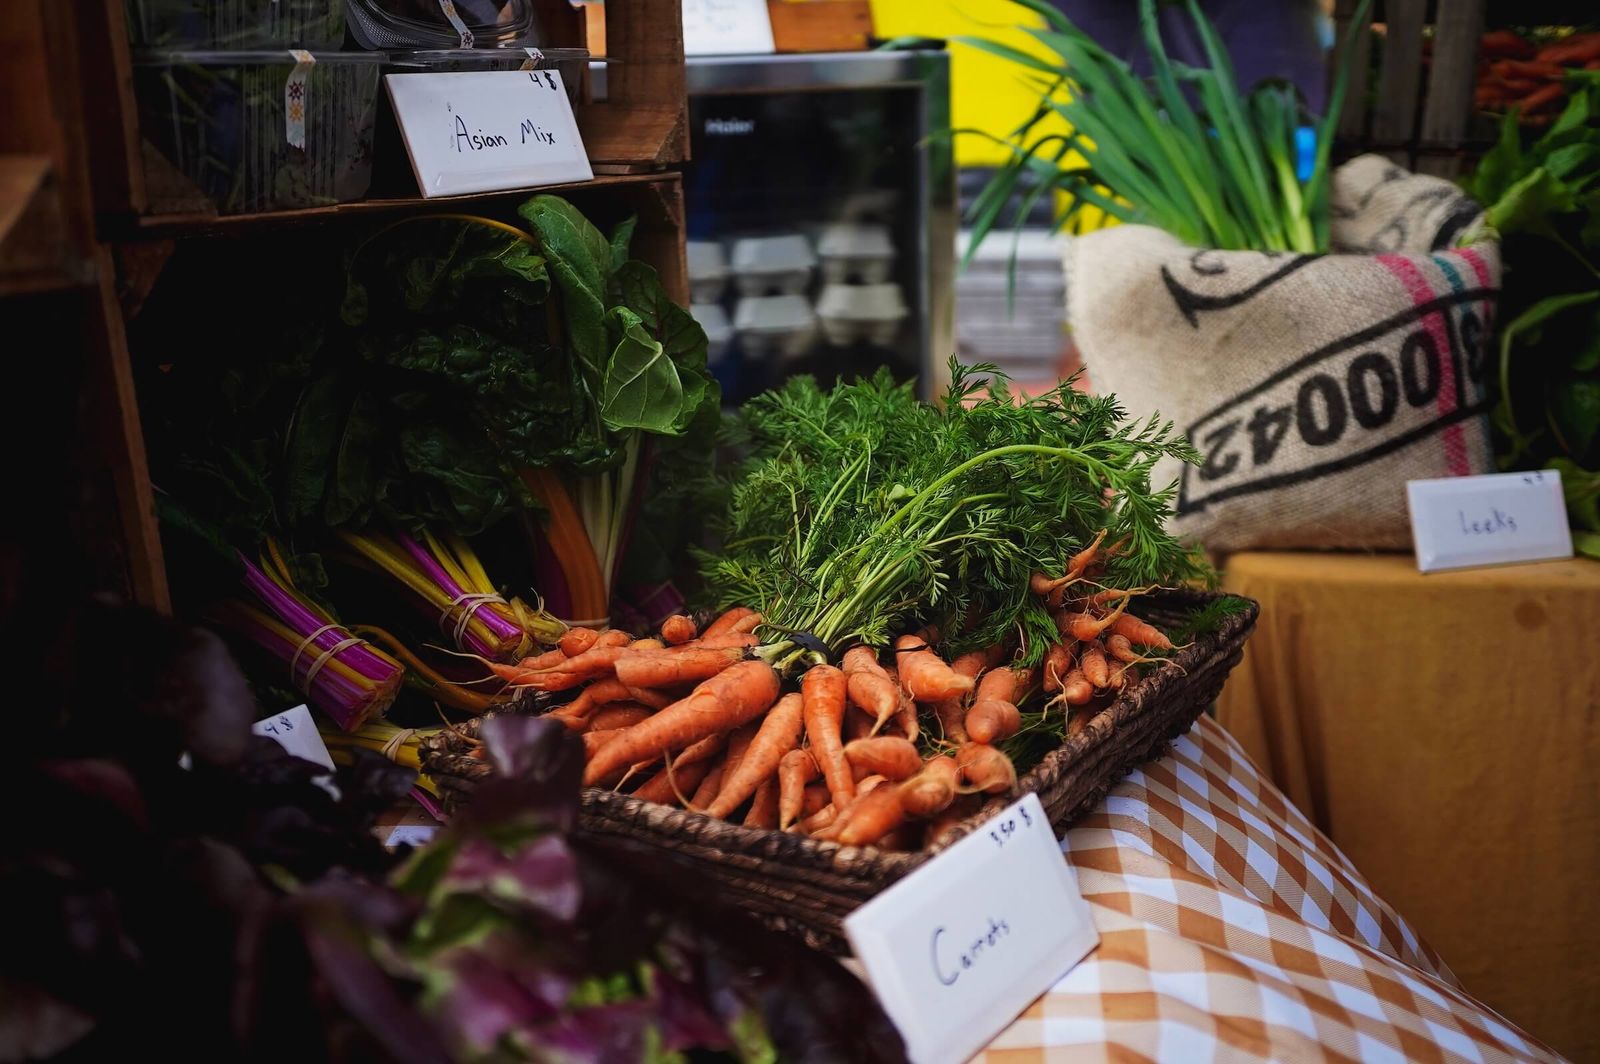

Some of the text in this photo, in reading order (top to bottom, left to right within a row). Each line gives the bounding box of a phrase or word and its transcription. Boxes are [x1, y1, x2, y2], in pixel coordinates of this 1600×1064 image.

[529, 73, 543, 88] 4
[455, 115, 556, 153] Asian Mix
[1201, 328, 1442, 482] 00042
[931, 917, 1010, 986] Carrots
